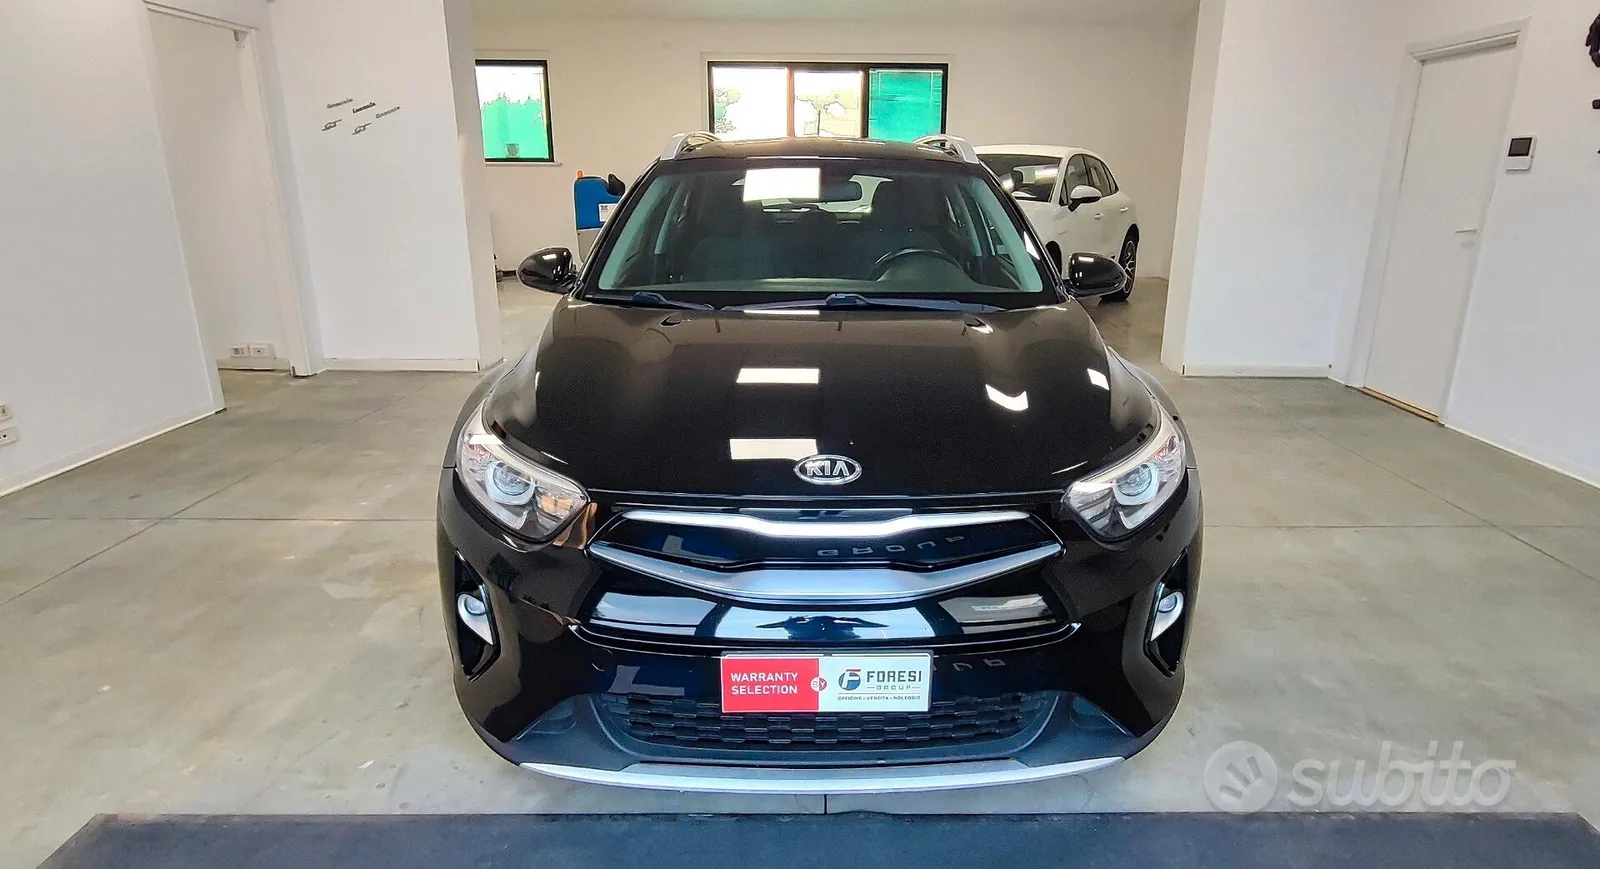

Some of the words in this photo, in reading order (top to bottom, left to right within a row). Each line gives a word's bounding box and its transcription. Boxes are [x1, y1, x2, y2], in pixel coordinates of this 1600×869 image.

[804, 460, 850, 476] KIA
[730, 672, 799, 682] WARRANTY
[866, 670, 922, 683] FORESI
[731, 685, 798, 695] SELECTION
